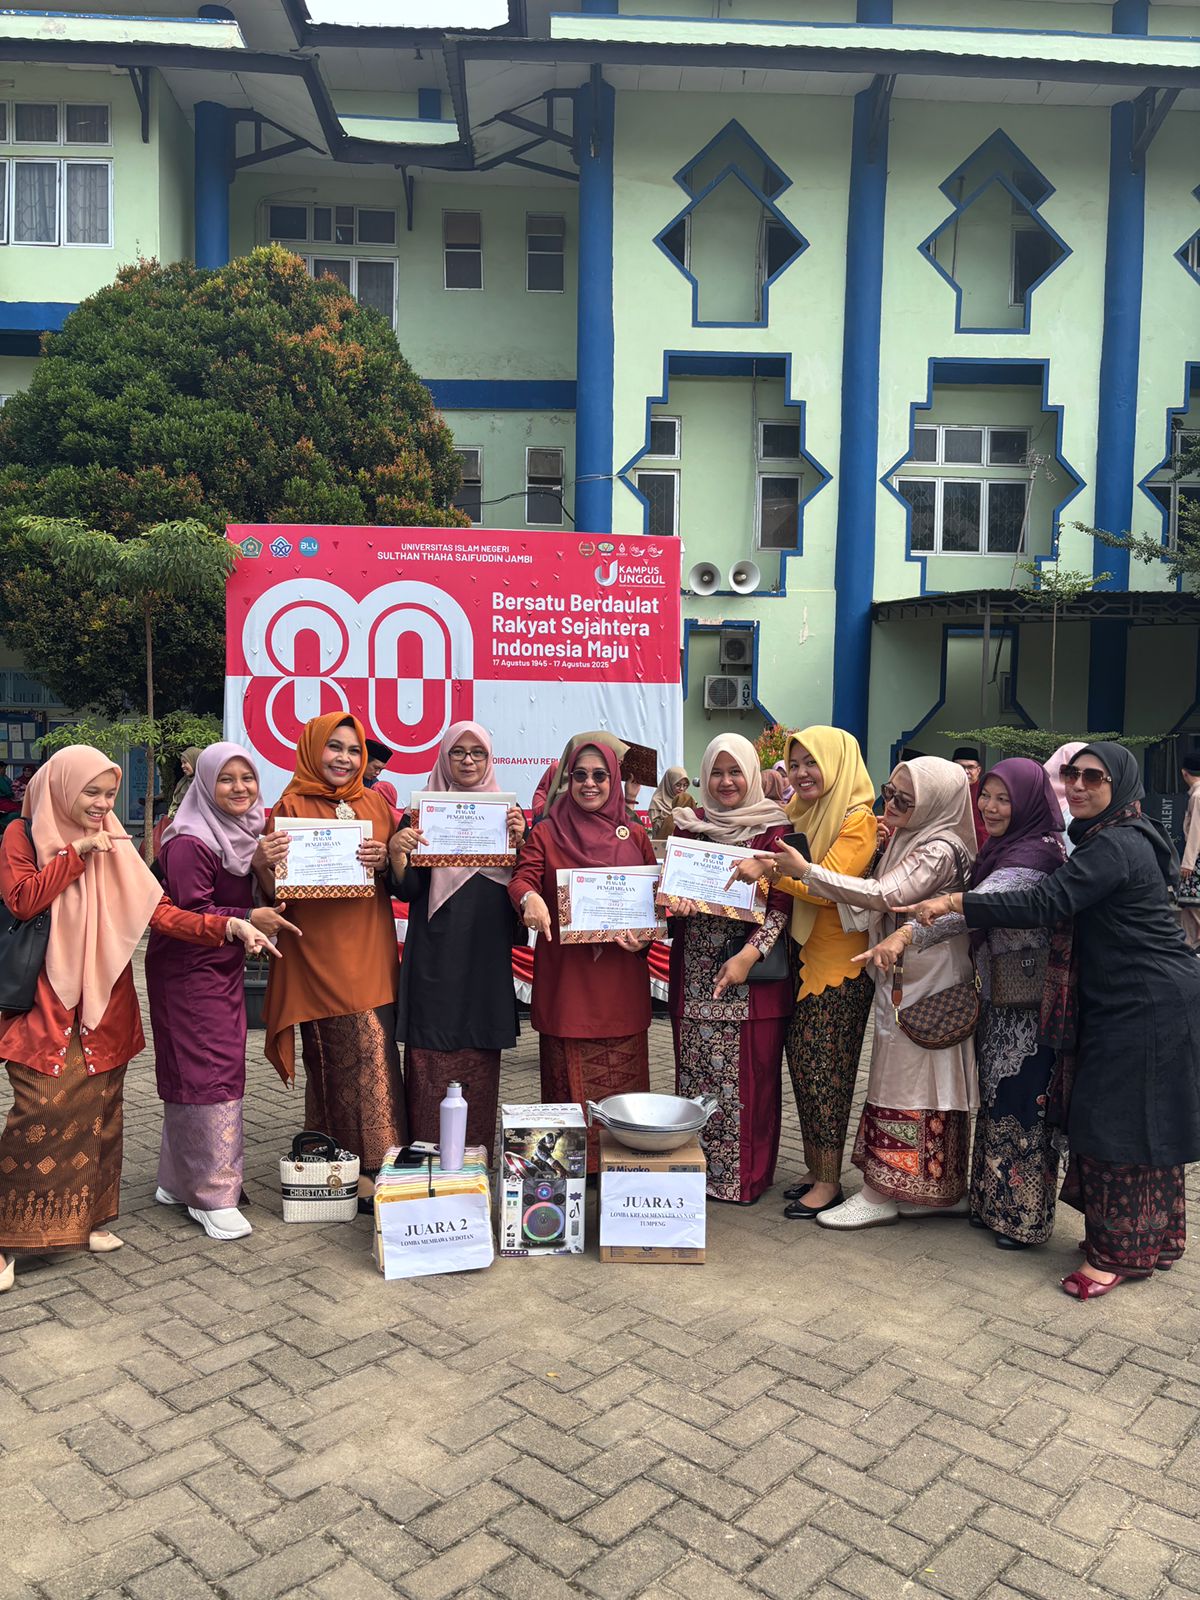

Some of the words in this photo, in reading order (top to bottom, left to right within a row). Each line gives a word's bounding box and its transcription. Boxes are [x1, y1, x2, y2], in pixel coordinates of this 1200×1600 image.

[401, 543, 453, 552] UNIVERSITAS
[455, 544, 480, 553] ISLAM
[481, 545, 510, 553] NEGERI
[377, 551, 420, 561] SULTHAN
[421, 552, 452, 562] THAHA
[455, 553, 503, 563] SAIFUDDIN
[504, 555, 533, 563] JAMBI
[619, 565, 660, 575] KAMPUS
[619, 574, 666, 585] UNGGUL
[492, 592, 566, 612] Bersatu
[570, 594, 660, 614] Berdaulat
[492, 615, 557, 638] Rakyat
[561, 617, 650, 639] Sejahtera
[492, 638, 583, 658] Indonesia
[588, 641, 630, 663] Maju
[501, 659, 530, 667] Agustus
[562, 661, 590, 669] Agustus
[742, 683, 751, 706] AUX
[492, 757, 539, 765] DIRGAHAYU
[1162, 798, 1173, 829] SILENT
[290, 1189, 328, 1197] CHRISTIAN
[331, 1188, 348, 1196] DIOR
[623, 1196, 672, 1208] JUARA
[676, 1197, 684, 1208] 3
[404, 1221, 456, 1237] JUARA
[460, 1218, 468, 1231] 2
